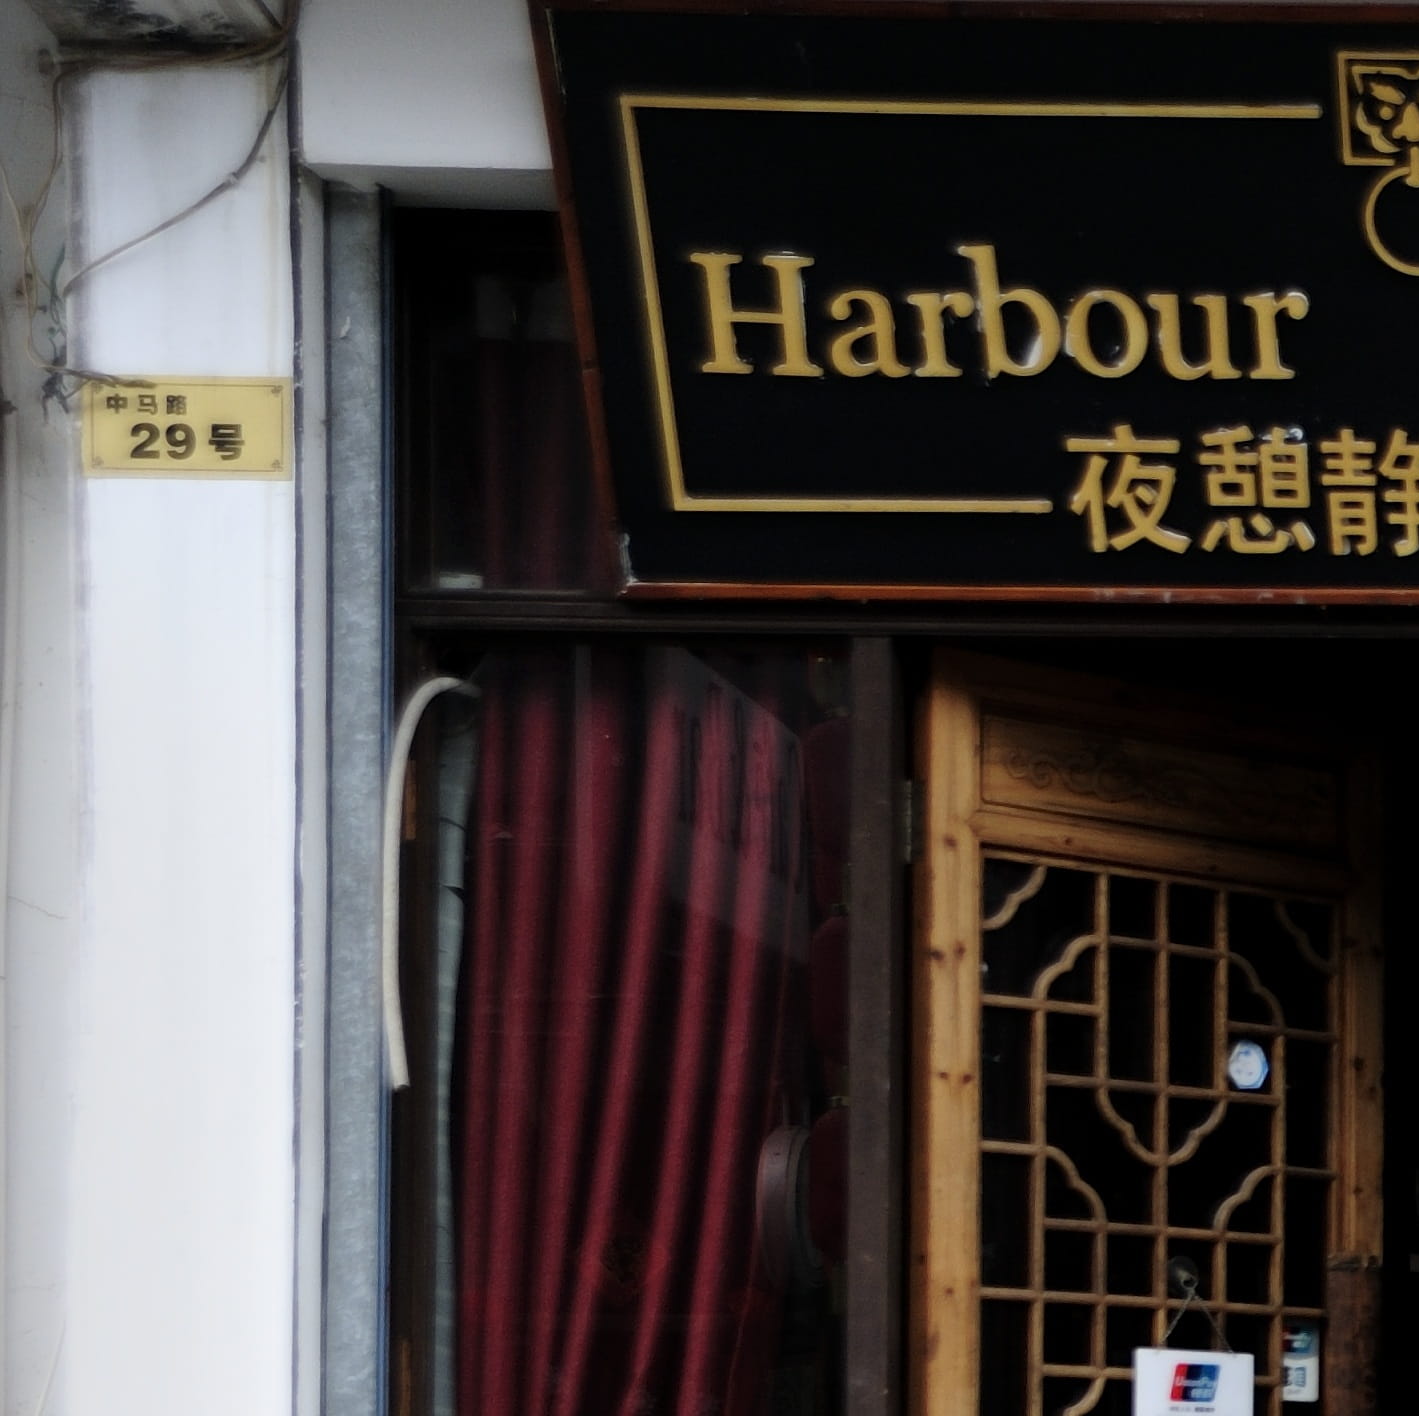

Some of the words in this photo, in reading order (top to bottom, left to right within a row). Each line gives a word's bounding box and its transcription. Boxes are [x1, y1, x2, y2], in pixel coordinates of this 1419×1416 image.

[690, 245, 1309, 380] Harbour
[106, 393, 187, 416] 中马路
[130, 422, 245, 461] 29号
